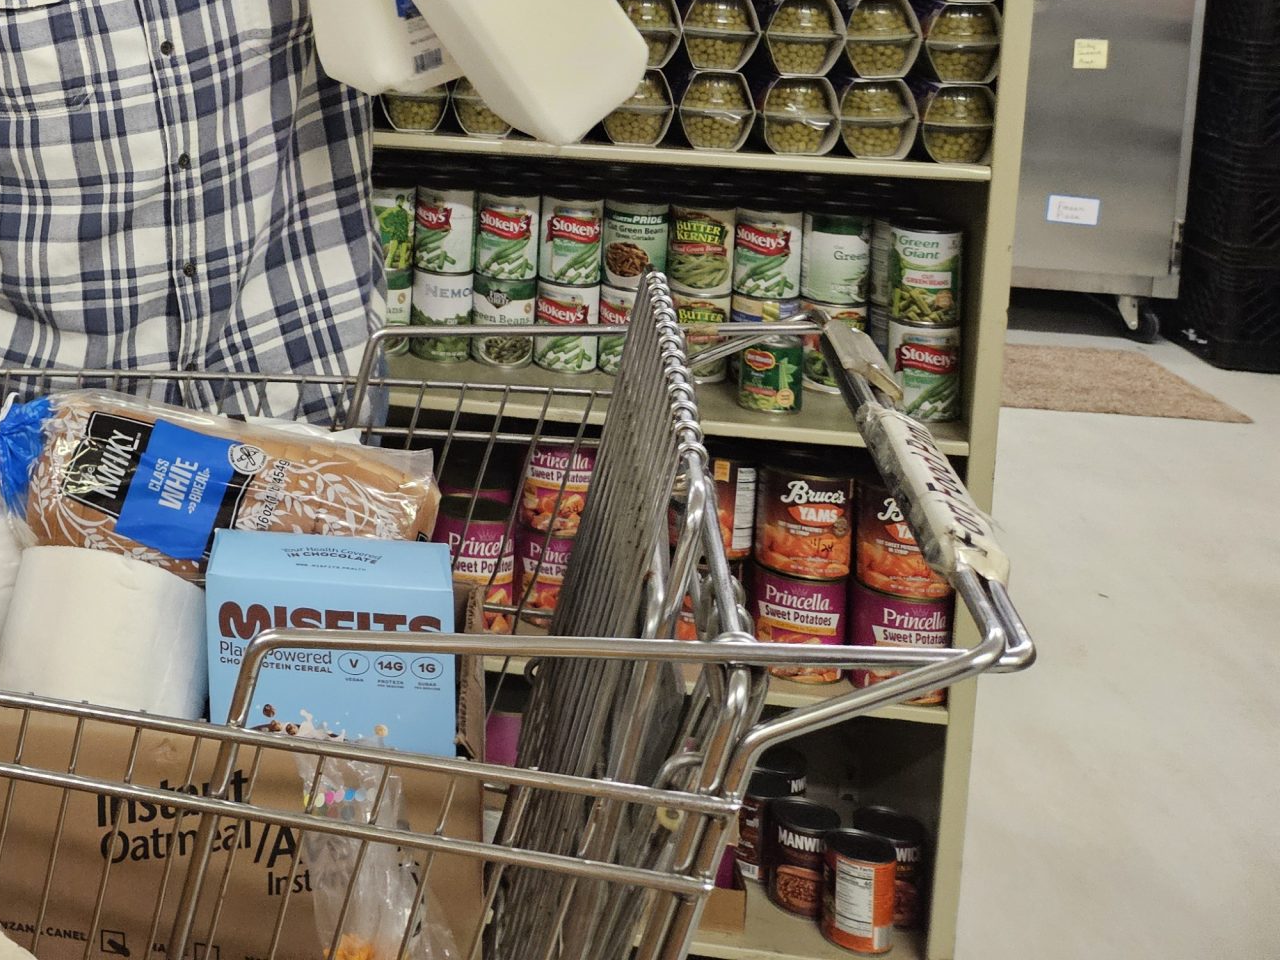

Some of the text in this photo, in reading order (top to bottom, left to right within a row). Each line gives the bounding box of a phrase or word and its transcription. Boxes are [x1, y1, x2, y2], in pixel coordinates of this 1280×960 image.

[480, 210, 528, 233] Stokely's
[552, 217, 600, 235] Stokely's
[632, 215, 663, 225] PRIDE
[620, 224, 643, 234] Green
[677, 220, 721, 236] BUTTER
[737, 227, 786, 249] Stokely's
[899, 235, 939, 248] Green
[902, 246, 940, 260] Giant
[537, 300, 583, 323] Stokely's
[530, 467, 555, 481] Sweet
[780, 481, 846, 504] Bruce's
[798, 506, 838, 522] YAMS
[303, 551, 379, 565] CHOCOLATE
[341, 548, 383, 560] Covered
[454, 560, 478, 572] weet
[766, 584, 831, 611] Princella
[765, 607, 832, 627] Sweet Potatoes
[883, 608, 946, 631] Princella
[883, 629, 913, 643] Sweet
[294, 663, 333, 674] CEREAL
[349, 658, 360, 669] V
[378, 660, 404, 672] 14G
[418, 662, 436, 673] 1G
